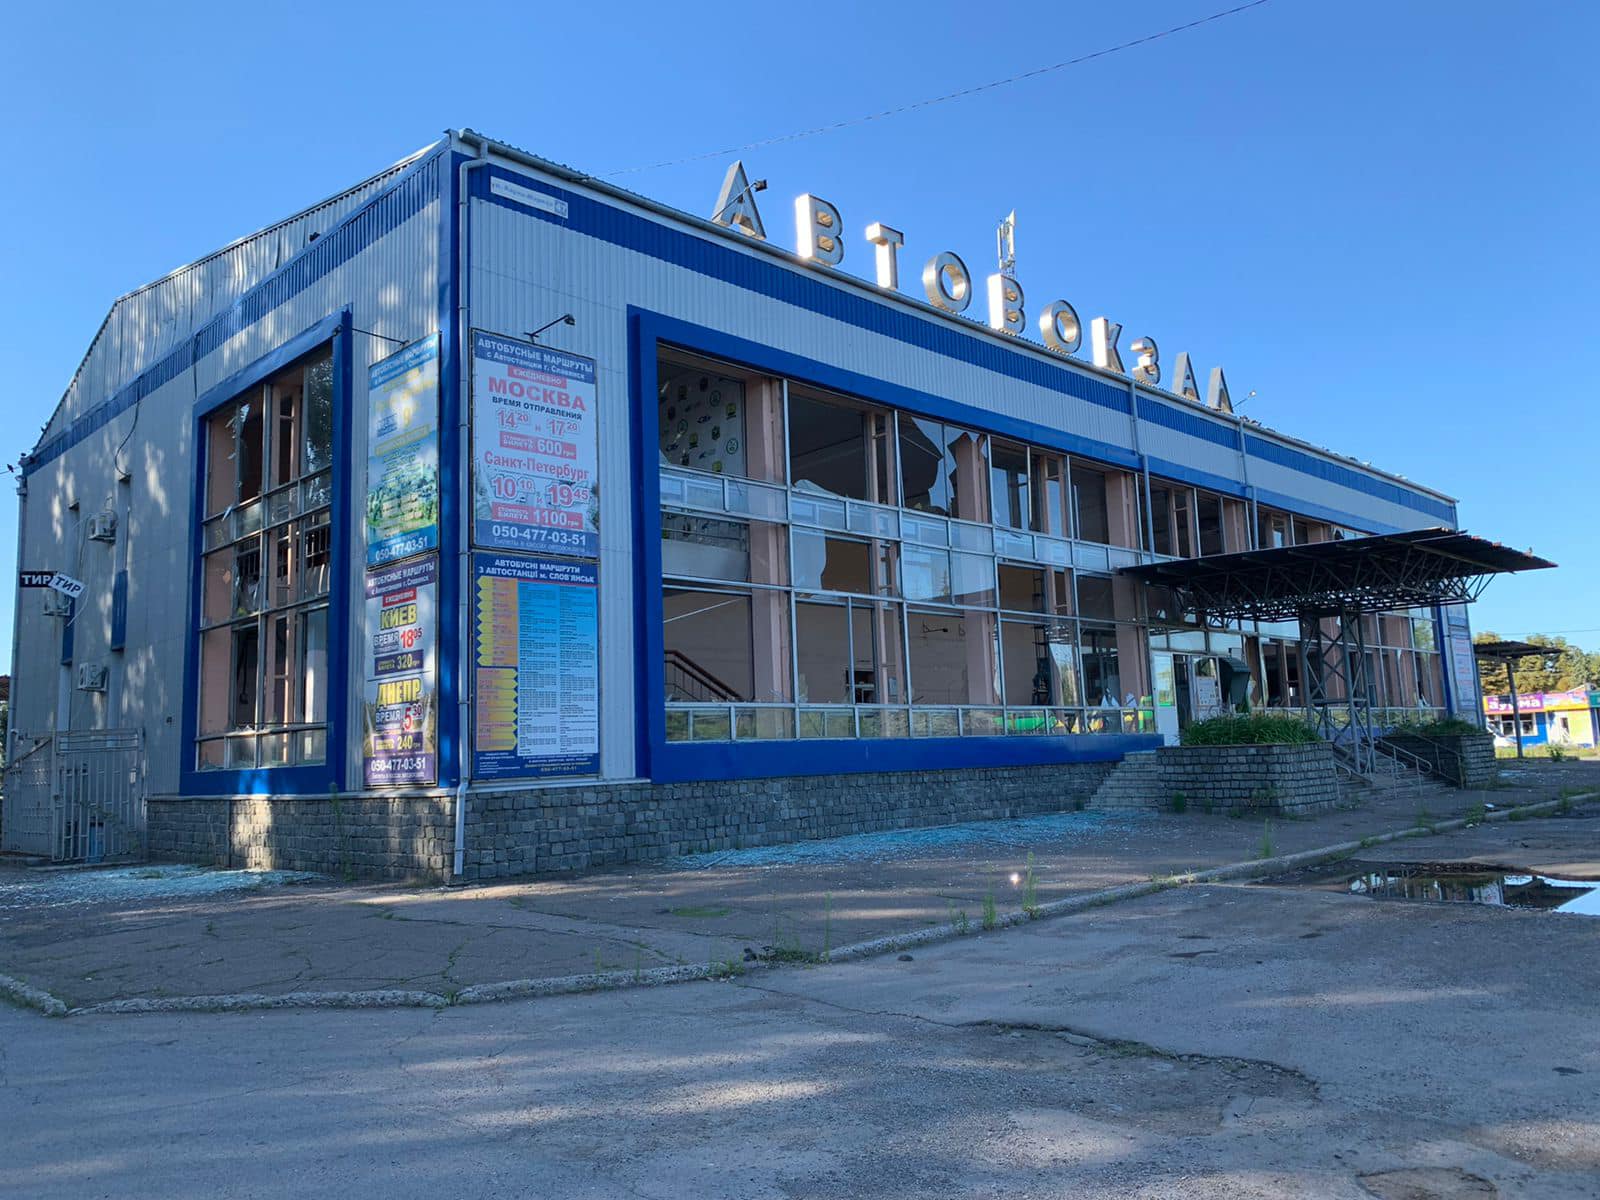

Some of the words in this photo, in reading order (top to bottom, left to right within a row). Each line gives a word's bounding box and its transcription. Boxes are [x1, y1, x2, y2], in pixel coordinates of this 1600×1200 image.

[711, 160, 1235, 412] АВТОВОКЗАЛ
[478, 338, 541, 359] АВТОБУСНЫЕ
[543, 354, 593, 372] МАРШРУТЫ
[489, 376, 586, 411] МОСКВА
[492, 396, 521, 408] ВРЕМЯ
[523, 402, 583, 420] ОТПРАВЛЕНИЯ
[484, 450, 590, 480] Санкт-Петербург
[492, 525, 586, 546] 050-477-03-51
[21, 575, 52, 585] ТИР
[55, 576, 82, 593] ТИР
[381, 604, 417, 630] КИЕВ
[377, 678, 421, 708] ДНЕПР
[371, 757, 426, 772] 050-477-03-51
